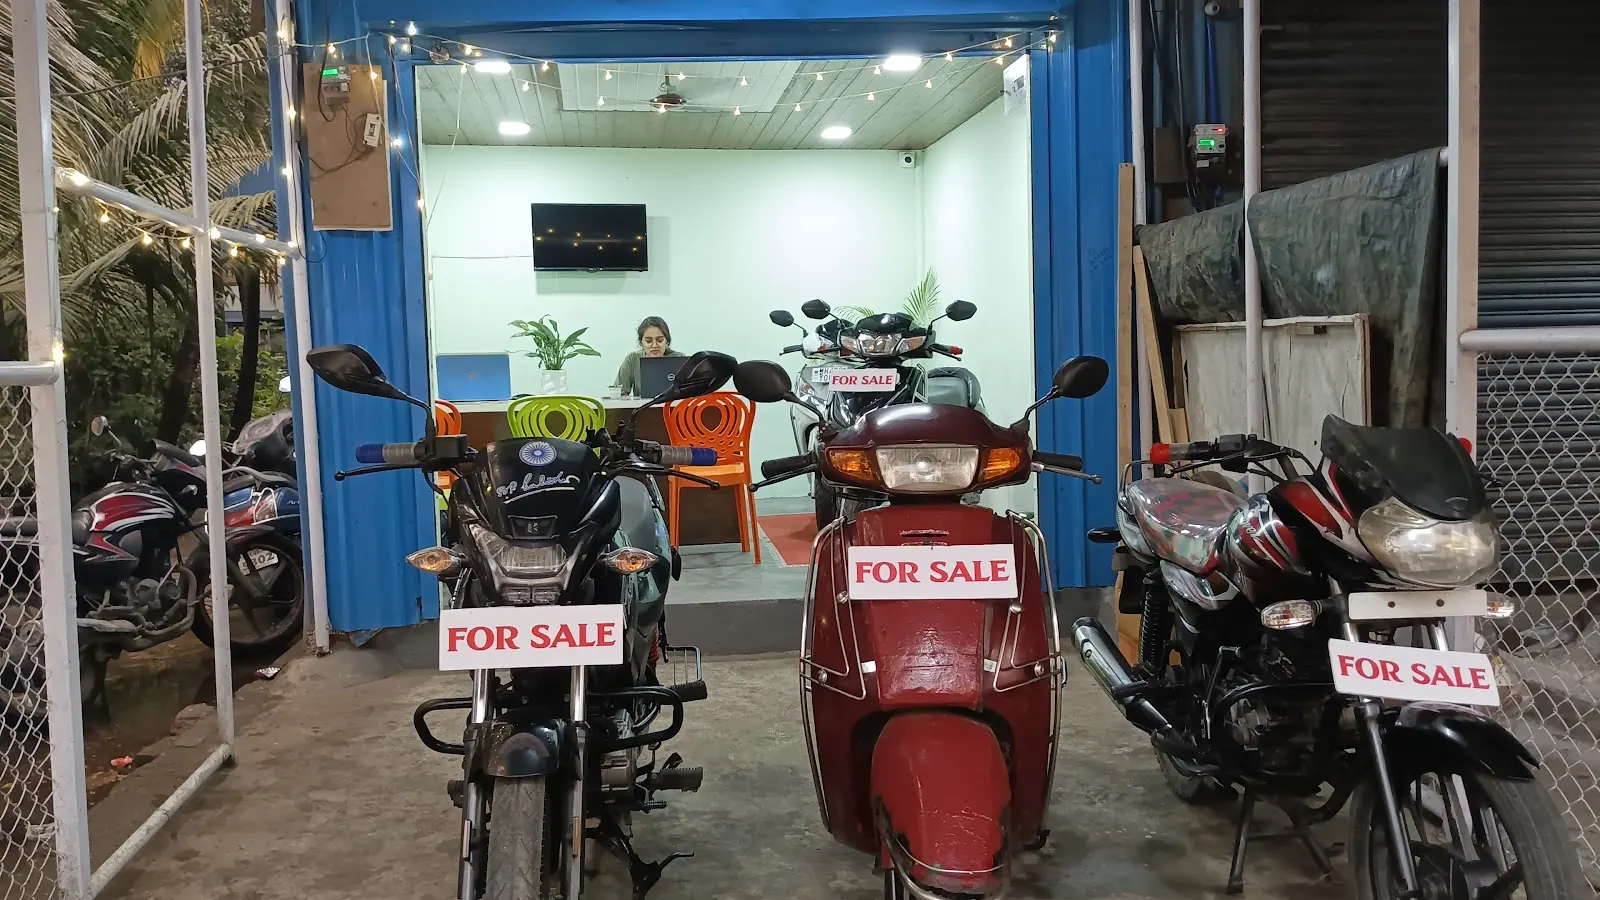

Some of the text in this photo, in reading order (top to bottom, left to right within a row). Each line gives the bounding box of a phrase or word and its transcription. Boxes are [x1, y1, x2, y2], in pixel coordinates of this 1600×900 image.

[831, 375, 893, 385] FOR SALE
[855, 559, 1010, 584] FOR SALE
[447, 622, 616, 652] FOR SALE
[1337, 654, 1490, 690] FOR SALE
